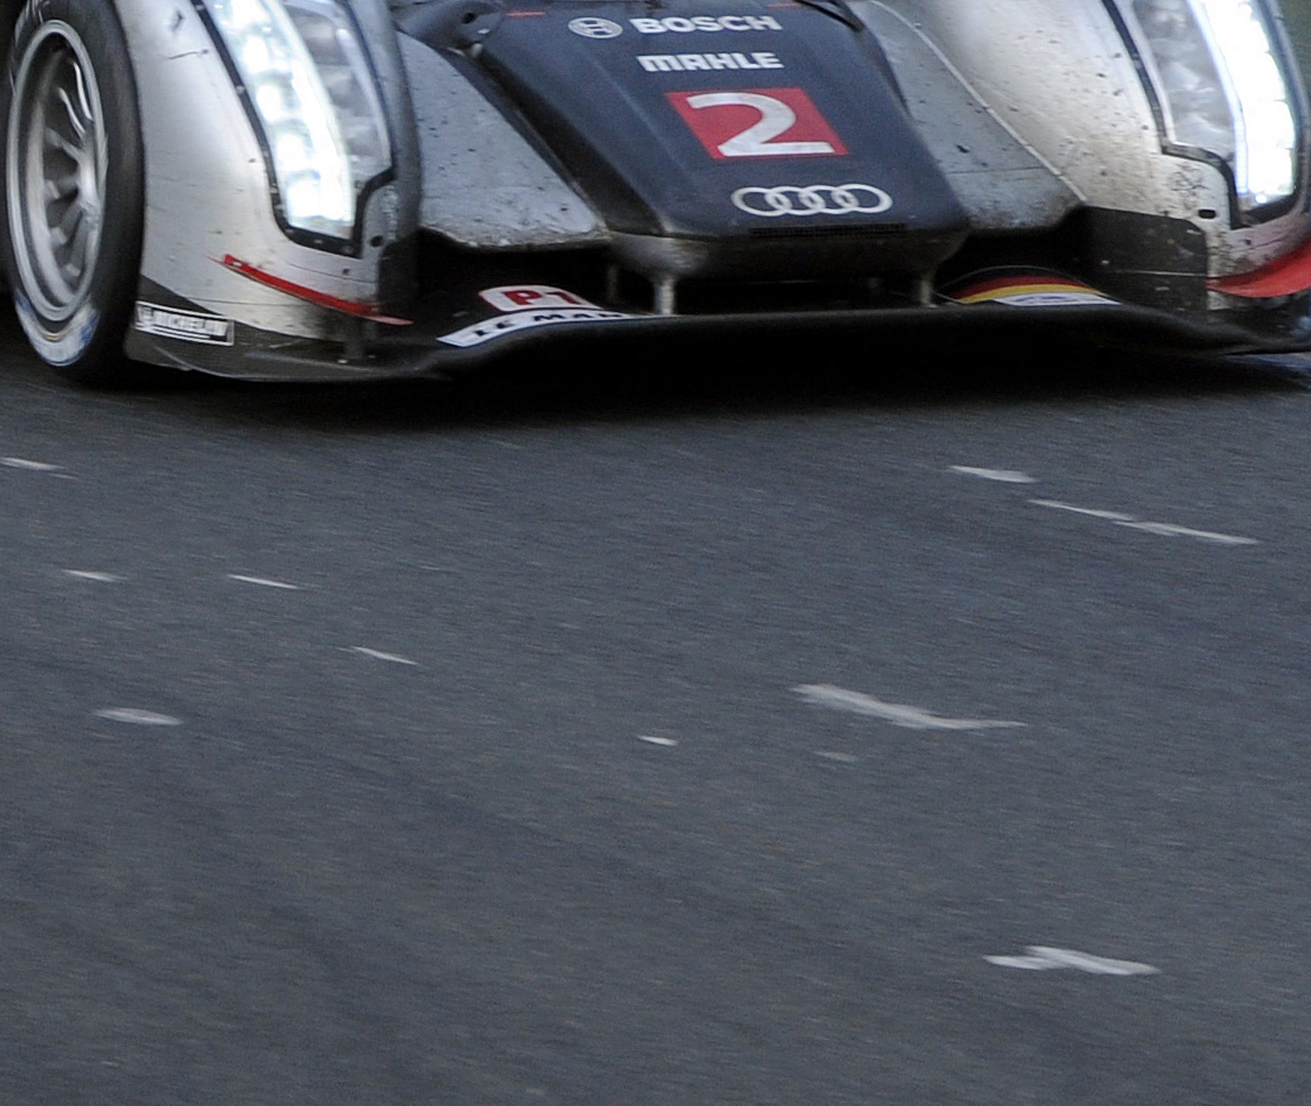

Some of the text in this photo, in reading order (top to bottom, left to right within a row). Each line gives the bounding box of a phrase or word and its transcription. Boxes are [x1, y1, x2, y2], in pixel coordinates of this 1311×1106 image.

[629, 15, 784, 34] BOSCH
[636, 52, 785, 72] MAHLE
[686, 92, 836, 157] 2
[502, 290, 582, 306] P1
